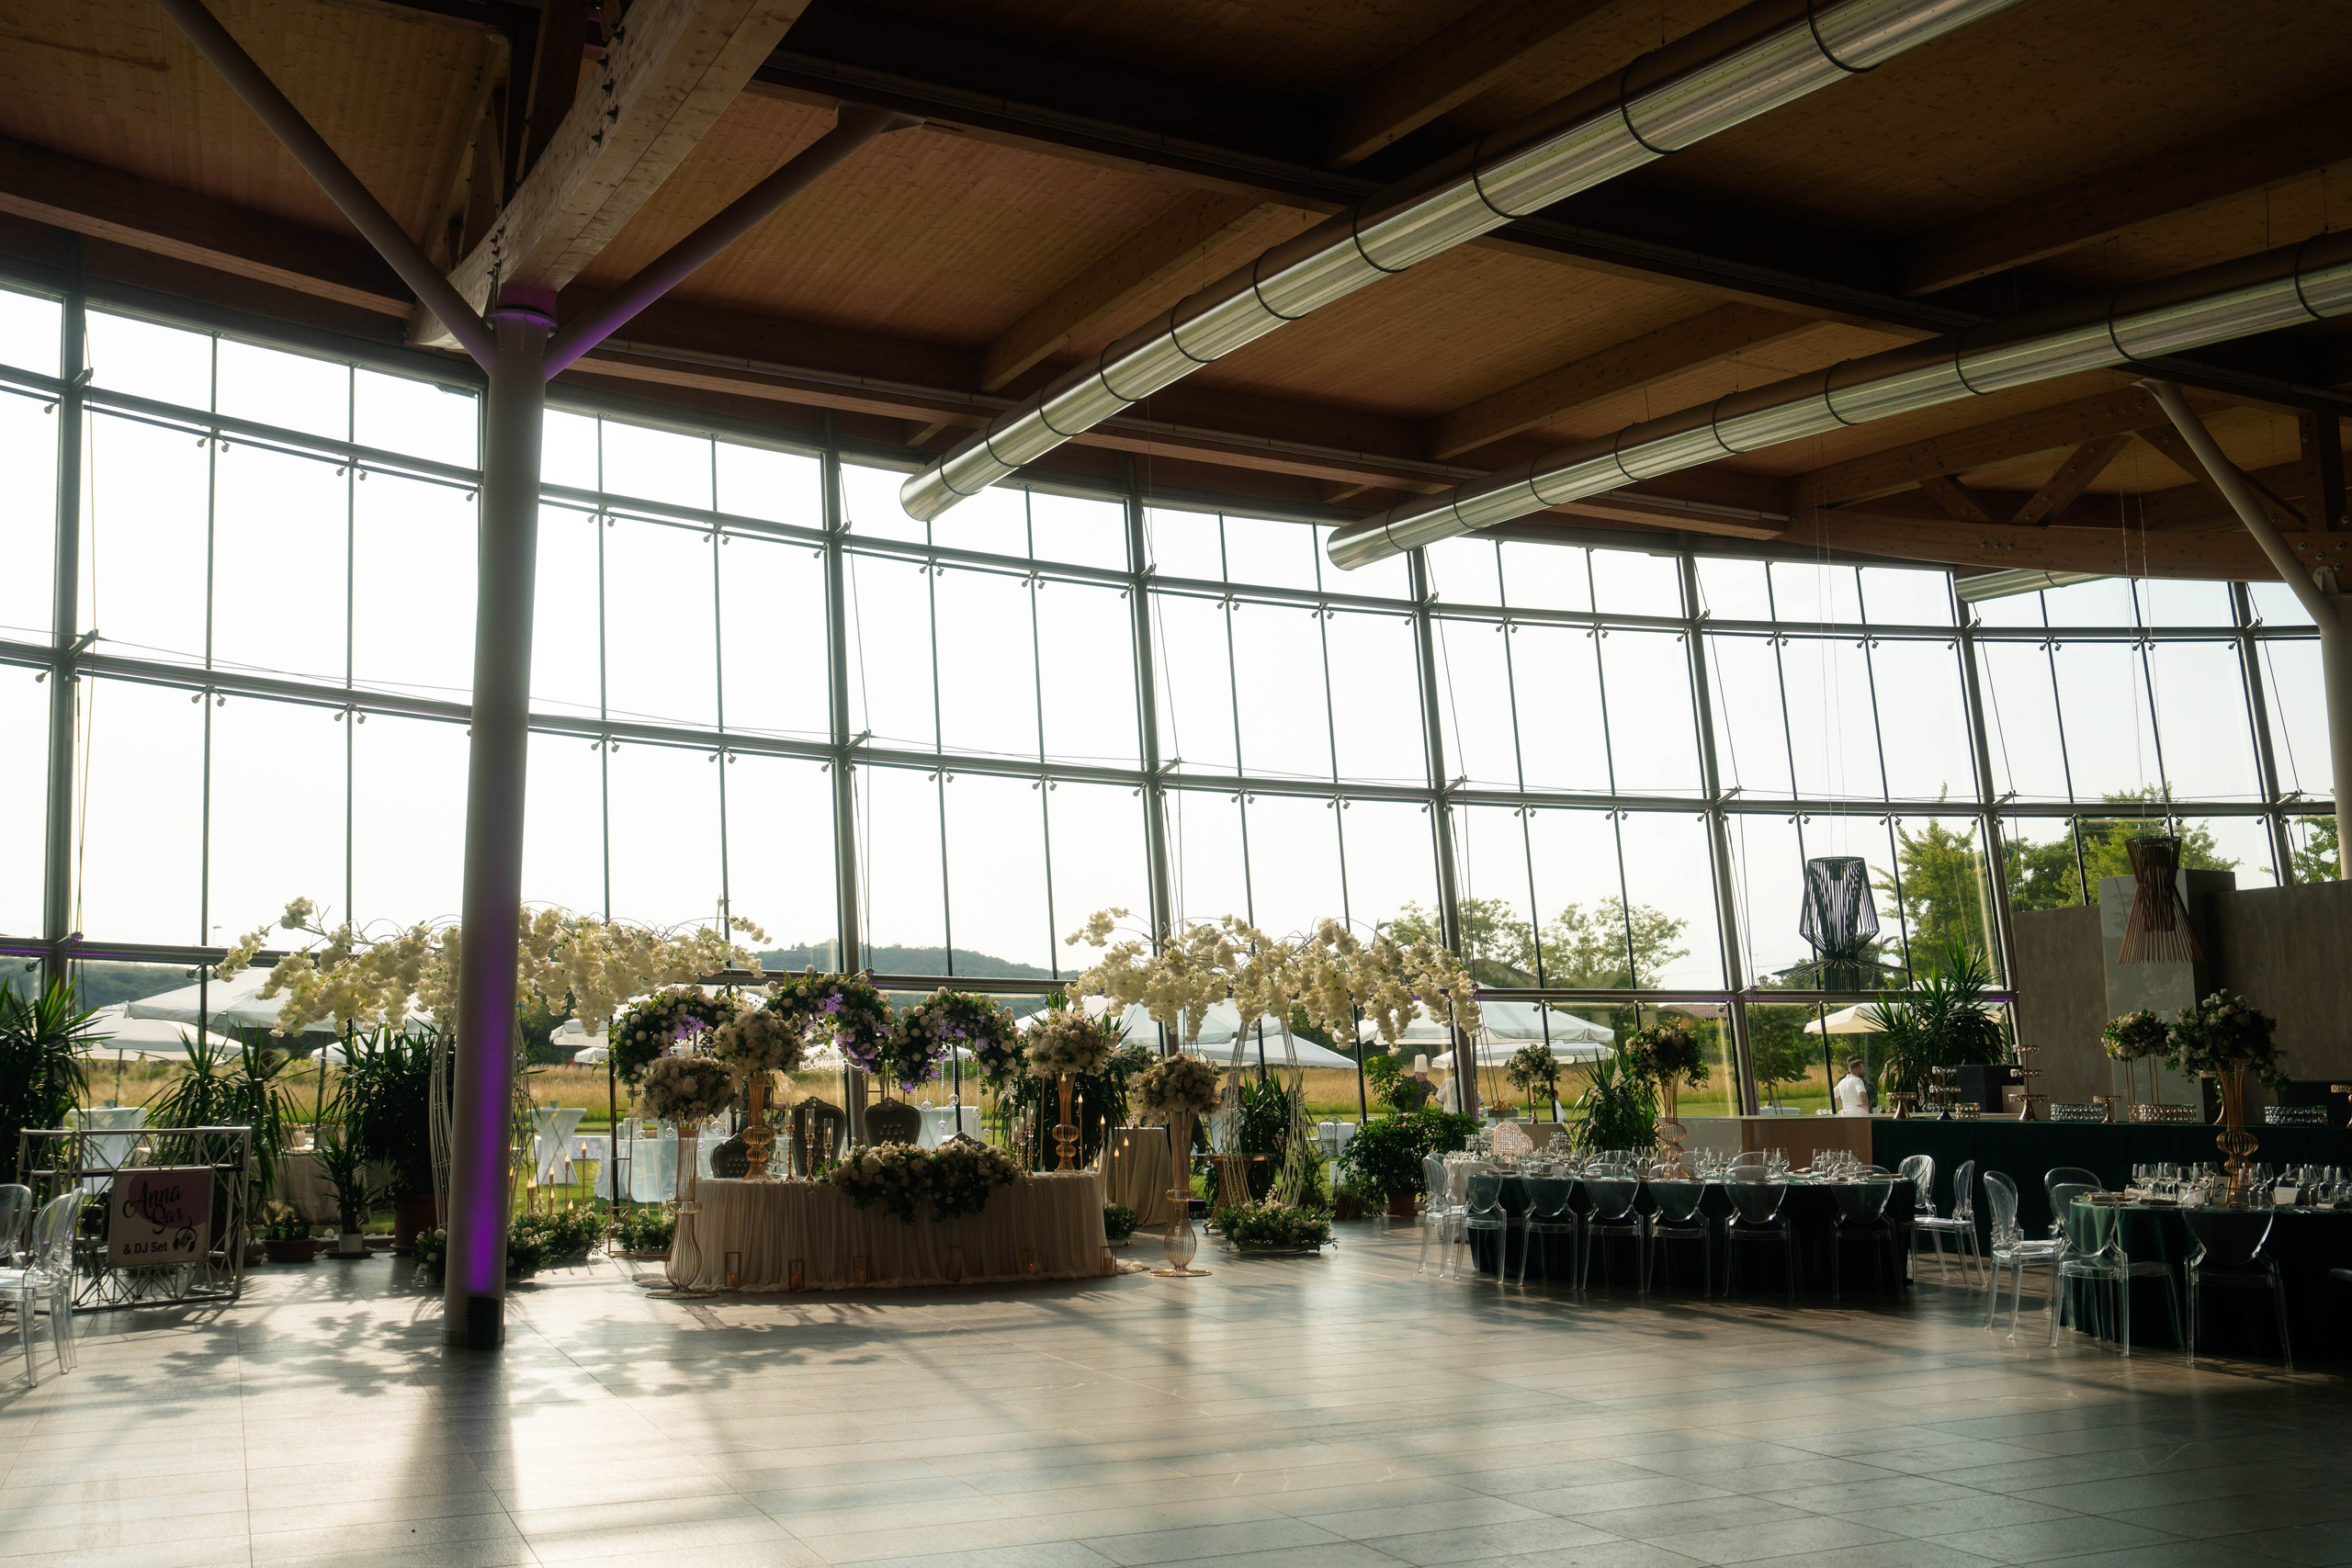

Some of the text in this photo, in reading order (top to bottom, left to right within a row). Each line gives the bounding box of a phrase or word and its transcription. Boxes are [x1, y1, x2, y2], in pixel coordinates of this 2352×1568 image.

[123, 1180, 183, 1218] Anna
[152, 1204, 184, 1235] Sax
[123, 1241, 168, 1255] & DJ Set
